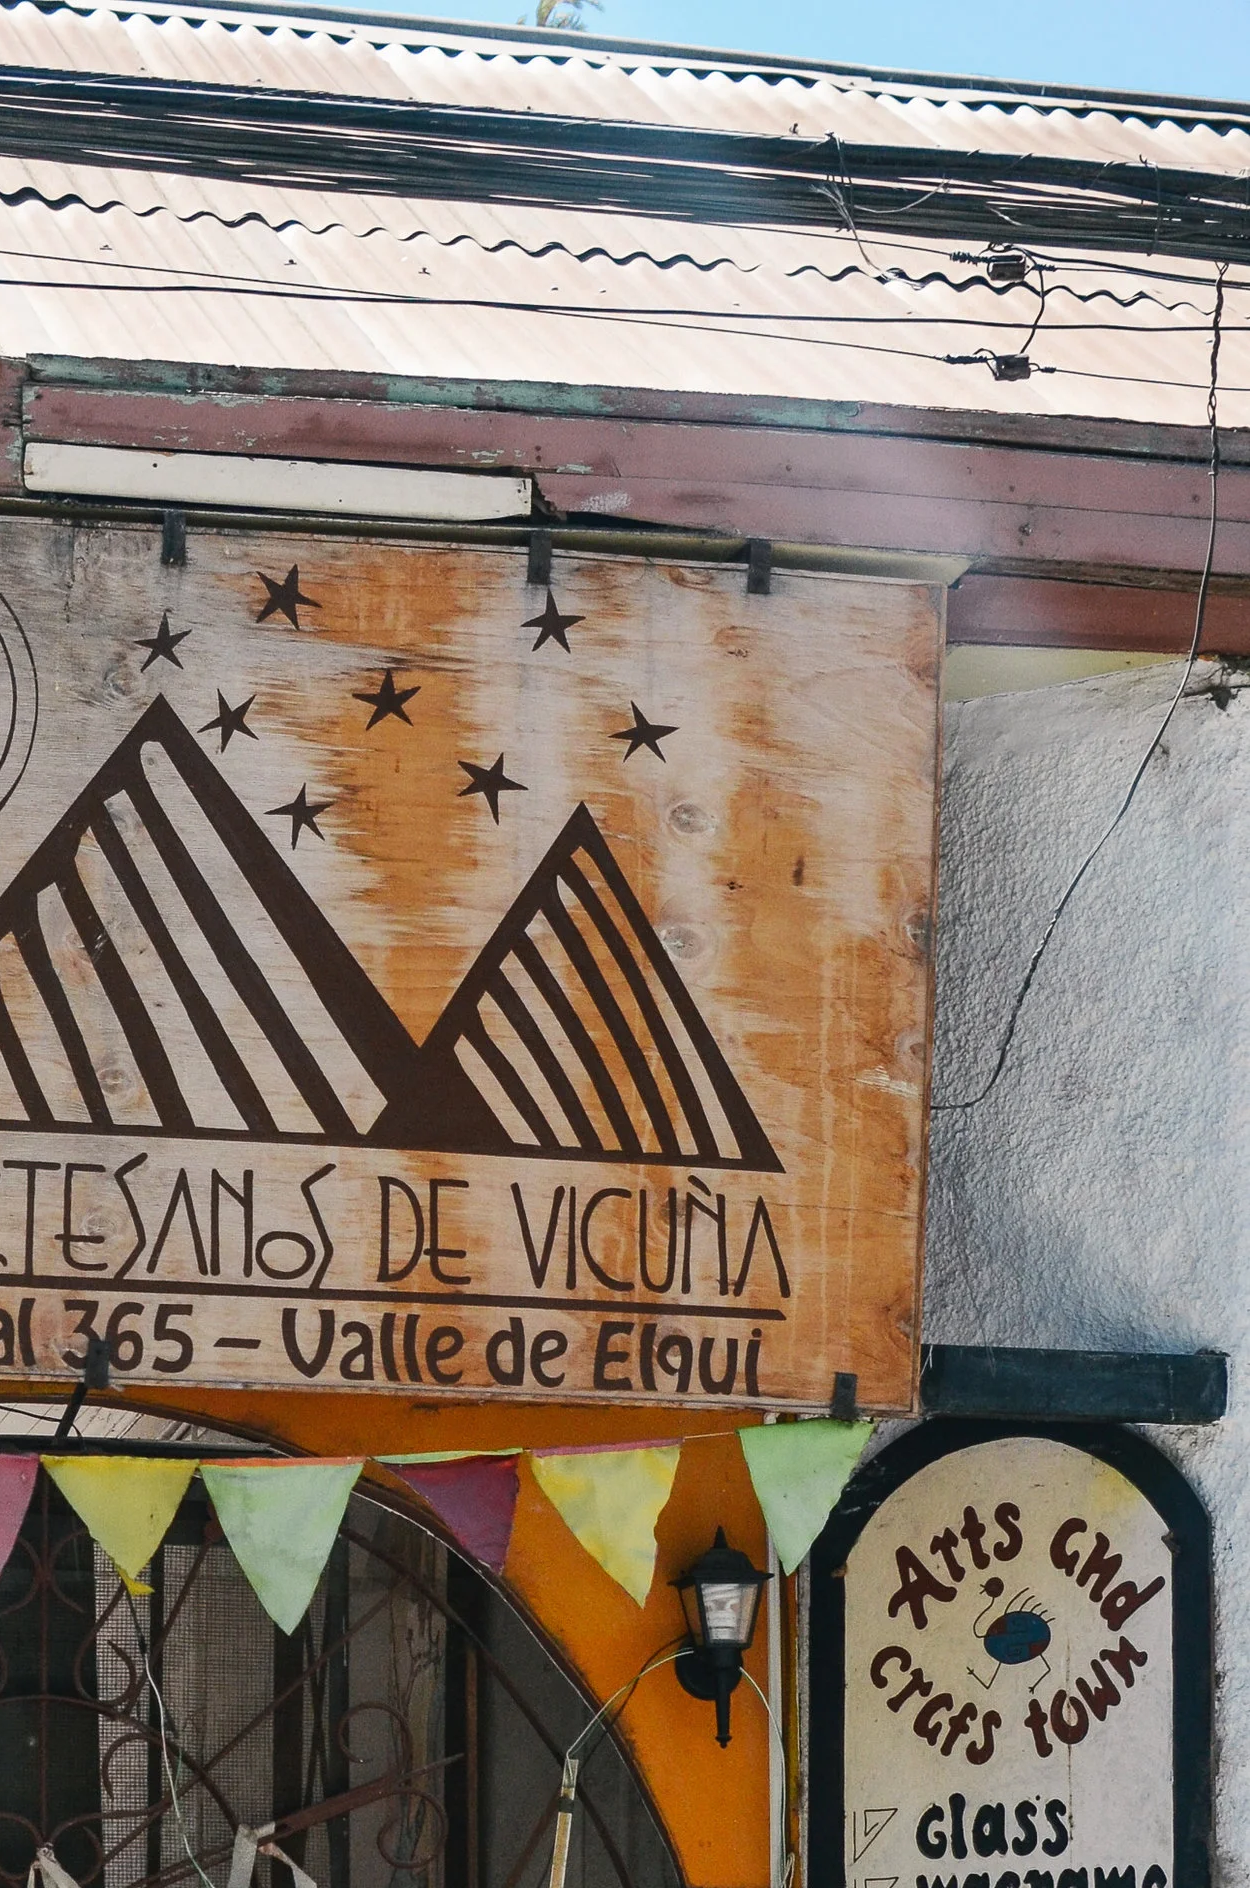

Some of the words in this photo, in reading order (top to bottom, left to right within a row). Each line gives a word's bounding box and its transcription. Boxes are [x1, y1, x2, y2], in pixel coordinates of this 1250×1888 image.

[377, 1174, 472, 1286] DE
[510, 1174, 792, 1298] VICUÑA
[61, 1299, 194, 1373] 365
[282, 1307, 464, 1384] Valle
[486, 1317, 568, 1387] de
[594, 1322, 763, 1398] Elqui
[888, 1502, 1024, 1631] Arts
[1050, 1517, 1166, 1632] and
[1024, 1636, 1148, 1759] town
